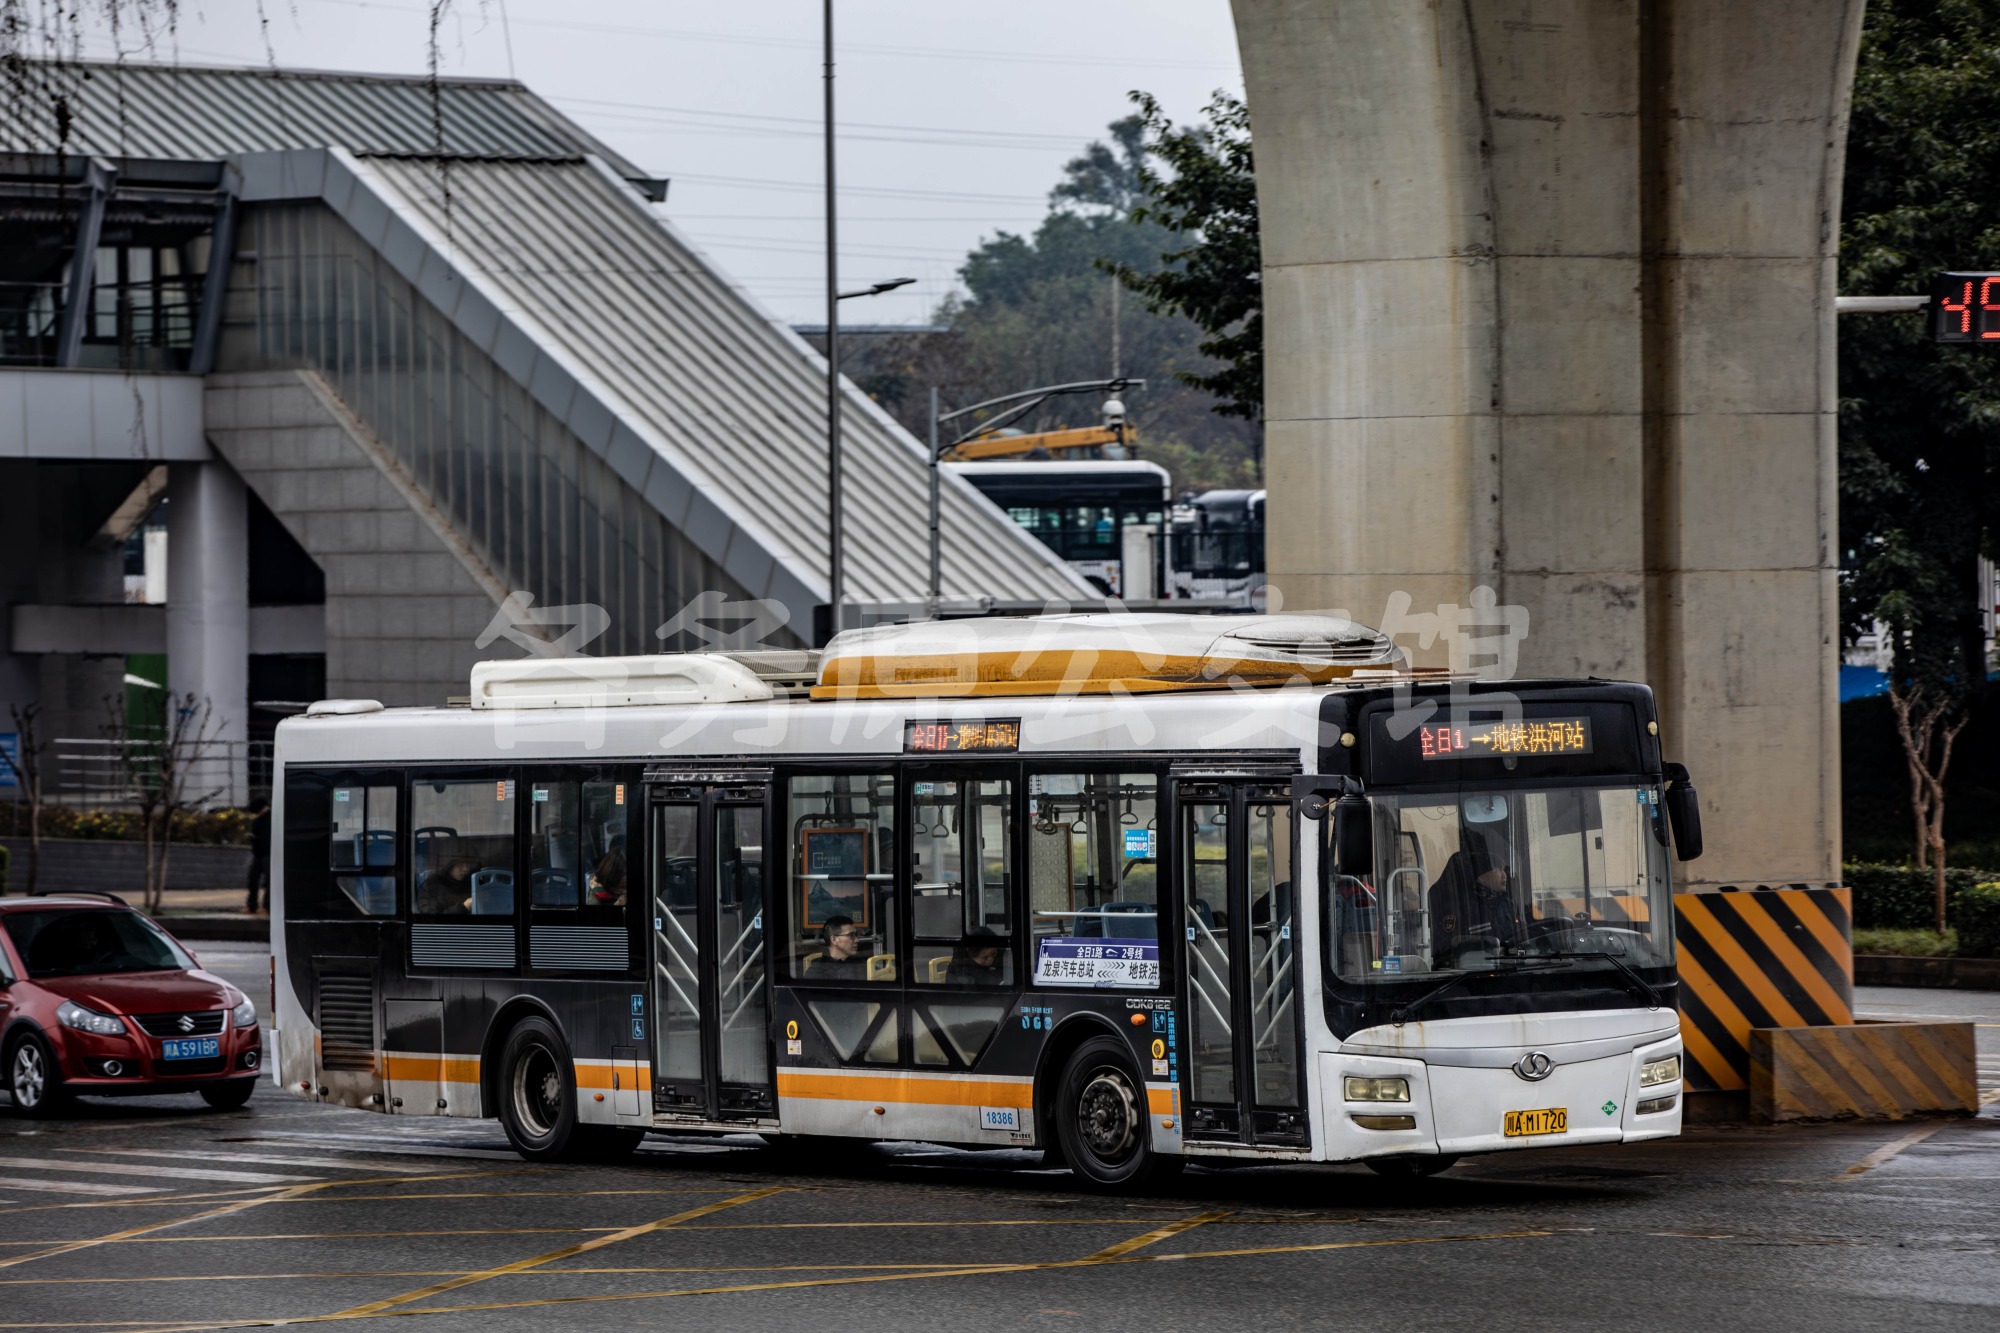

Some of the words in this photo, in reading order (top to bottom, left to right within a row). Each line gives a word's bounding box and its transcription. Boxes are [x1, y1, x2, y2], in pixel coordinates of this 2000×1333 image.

[1420, 726, 1464, 756] 全日1
[1490, 720, 1585, 752] 地铁洪河站
[1076, 946, 1103, 959] 全日1路
[1121, 947, 1144, 960] 2号线
[1042, 960, 1095, 978] 龙泉汽车总站
[1128, 961, 1160, 980] 地铁洪
[1603, 1104, 1615, 1112] CNG
[986, 1111, 1013, 1125] 18386
